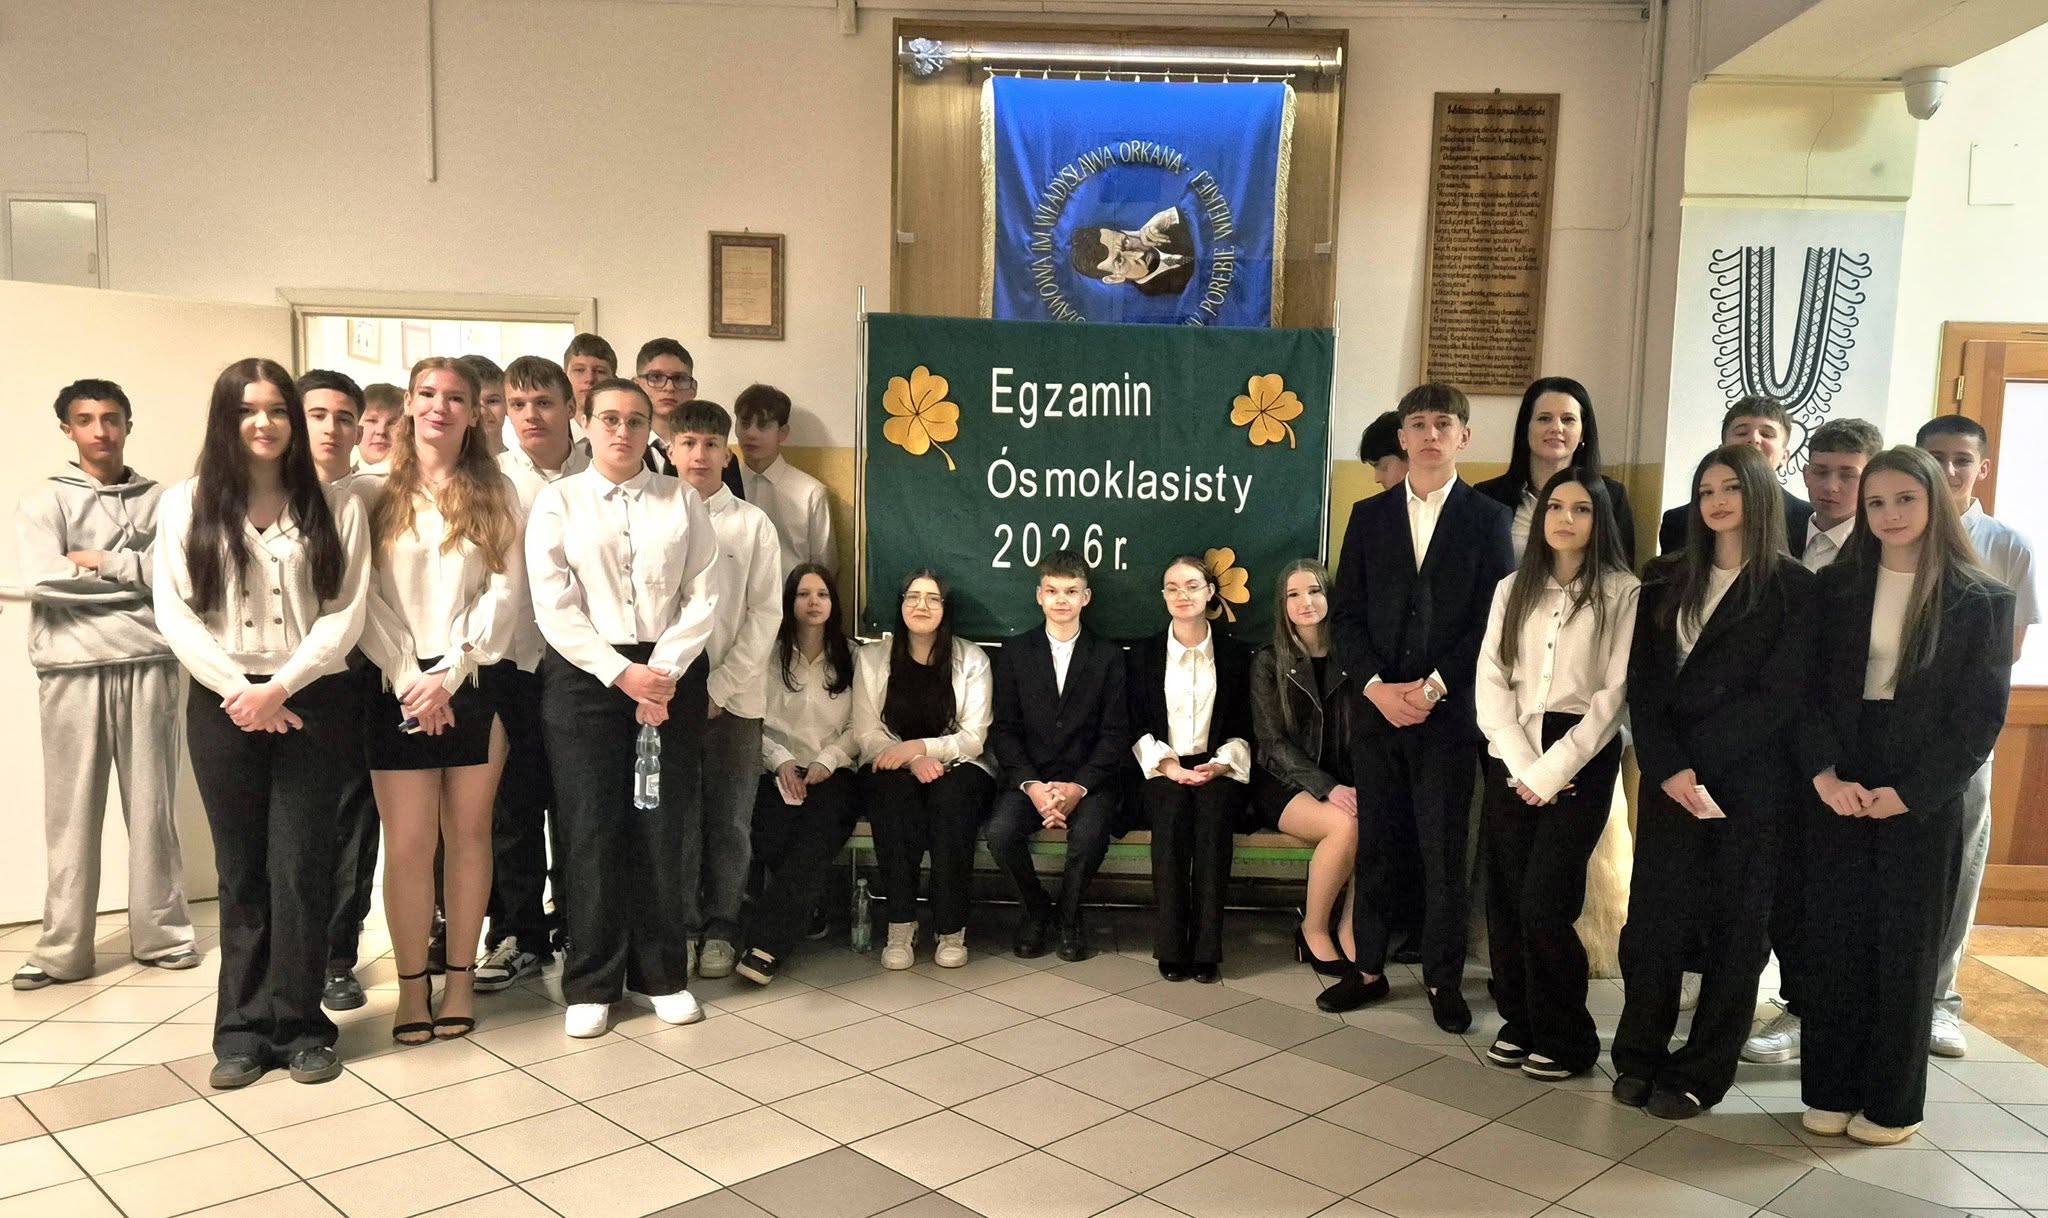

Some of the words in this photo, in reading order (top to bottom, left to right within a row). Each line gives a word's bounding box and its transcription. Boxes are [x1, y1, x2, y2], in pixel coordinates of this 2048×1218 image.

[1190, 170, 1233, 241] WIELKIEJ
[990, 366, 1152, 429] Egzamin
[986, 446, 1253, 514] Ósmoklasisty
